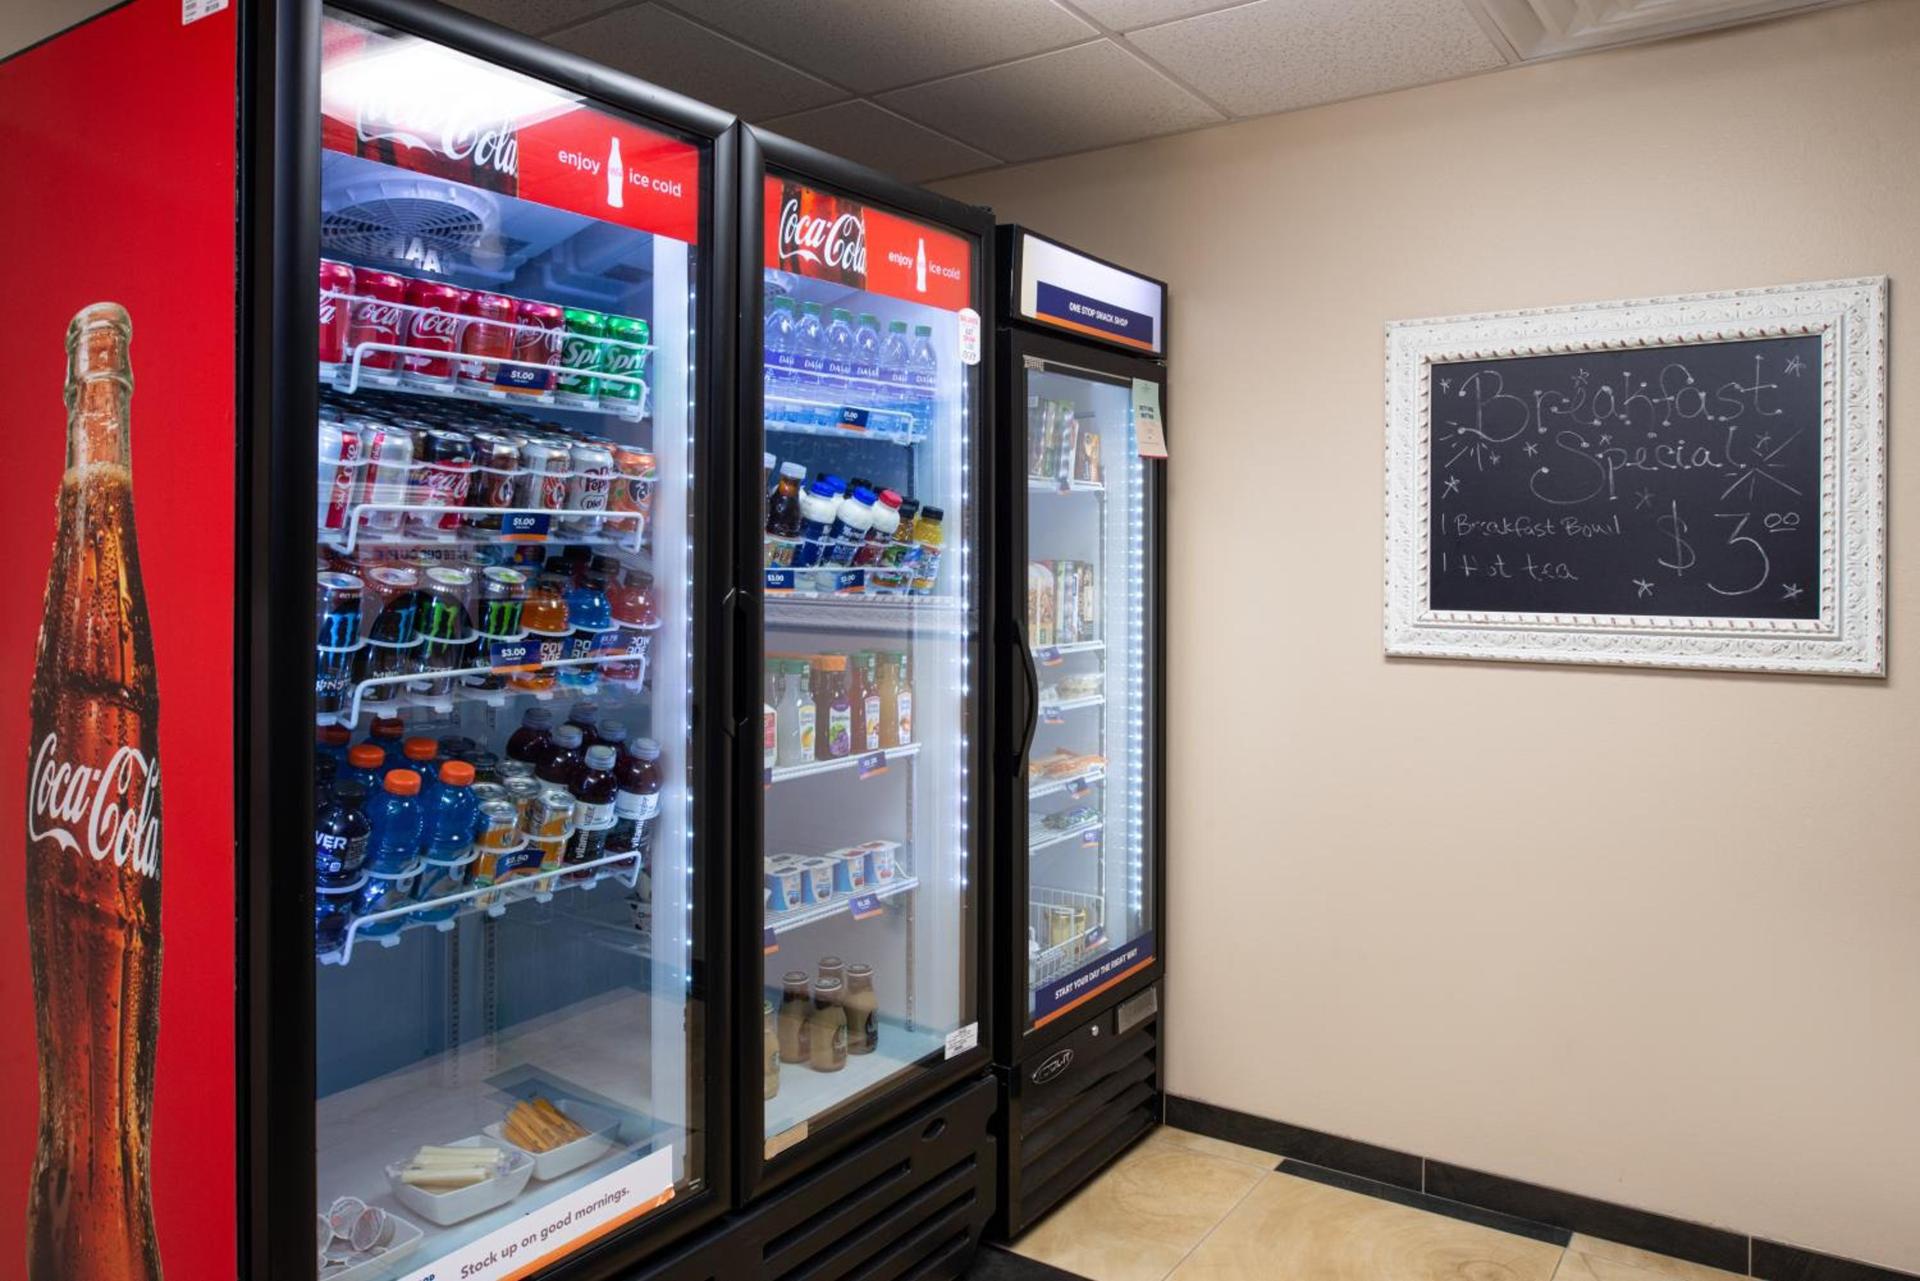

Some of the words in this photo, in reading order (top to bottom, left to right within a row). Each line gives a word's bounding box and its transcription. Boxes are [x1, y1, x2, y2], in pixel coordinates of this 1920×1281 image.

[558, 149, 601, 176] enjoy
[629, 168, 649, 187] ice
[652, 178, 682, 198] cold
[778, 198, 867, 276] Coca-Cola
[888, 251, 913, 269] enjoy
[928, 261, 941, 276] ice
[942, 264, 961, 281] cold
[1068, 301, 1081, 314] ONE
[1081, 305, 1096, 318] STOP
[1095, 310, 1113, 322] SNACK
[1113, 315, 1129, 328] SHOP
[510, 370, 535, 381] $1.00
[1530, 426, 1747, 504] Special
[512, 516, 536, 527] $1.00
[1454, 513, 1556, 539] Breakfast
[1521, 552, 1580, 582] tea
[501, 647, 527, 658] $3.00
[29, 732, 159, 879] Coca-Cola
[1055, 983, 1073, 1000] START
[1073, 974, 1089, 990] YOUR
[1088, 968, 1100, 981] DAY
[1100, 962, 1110, 975] THE
[1110, 954, 1127, 970] RIGHT
[1126, 948, 1138, 960] WAY
[460, 1251, 498, 1280] Stock
[501, 1242, 518, 1260] up
[521, 1233, 537, 1248] on
[540, 1212, 572, 1242] good
[574, 1186, 631, 1222] mornings.
